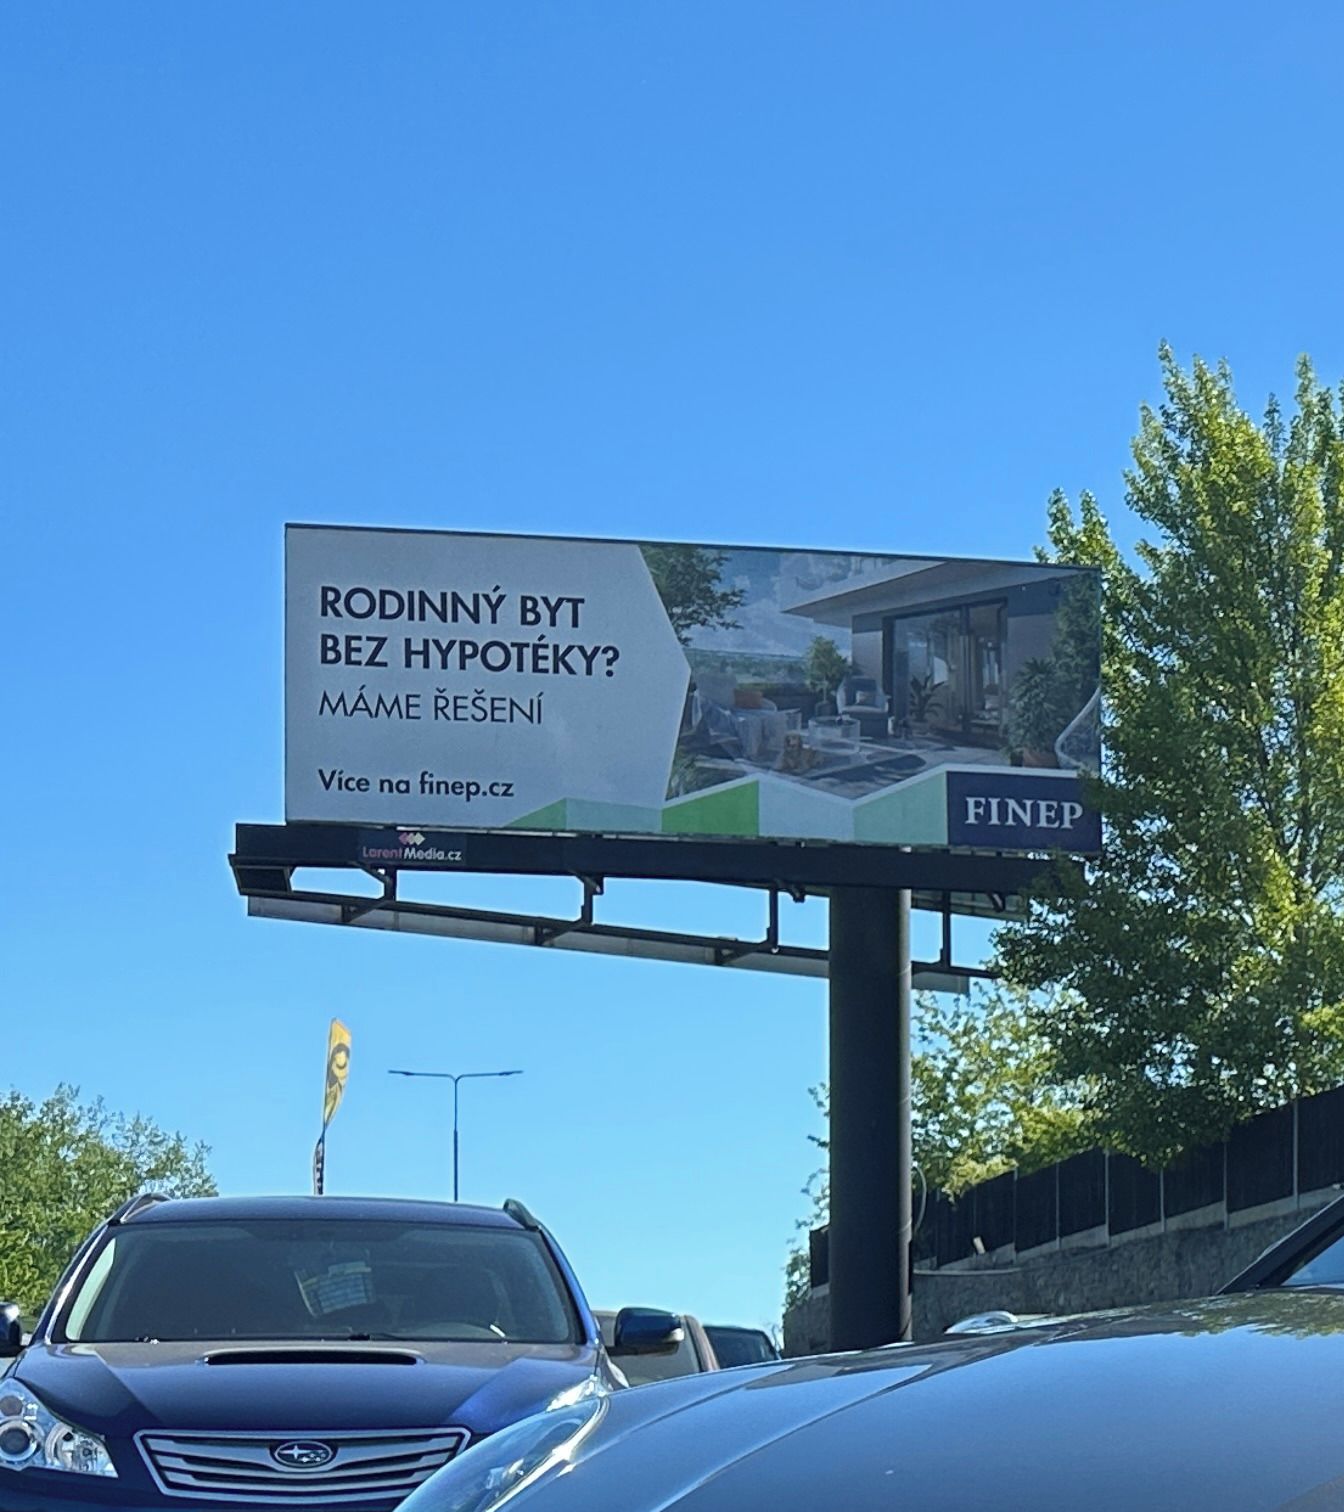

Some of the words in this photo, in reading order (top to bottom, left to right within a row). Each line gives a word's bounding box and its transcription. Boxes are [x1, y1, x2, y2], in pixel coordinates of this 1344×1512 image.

[320, 585, 507, 625] RODINNÝ
[520, 595, 585, 628] BYT
[320, 633, 388, 667] BEZ
[404, 634, 620, 678] HYPOTÉKY?
[318, 684, 422, 720] MÁME
[434, 687, 544, 725] ŘEŠENÍ
[318, 768, 371, 792] Více
[379, 777, 410, 794] na
[419, 770, 514, 802] finep.cz
[964, 796, 1083, 829] FINEP
[362, 846, 462, 861] LarentMedia.cz
